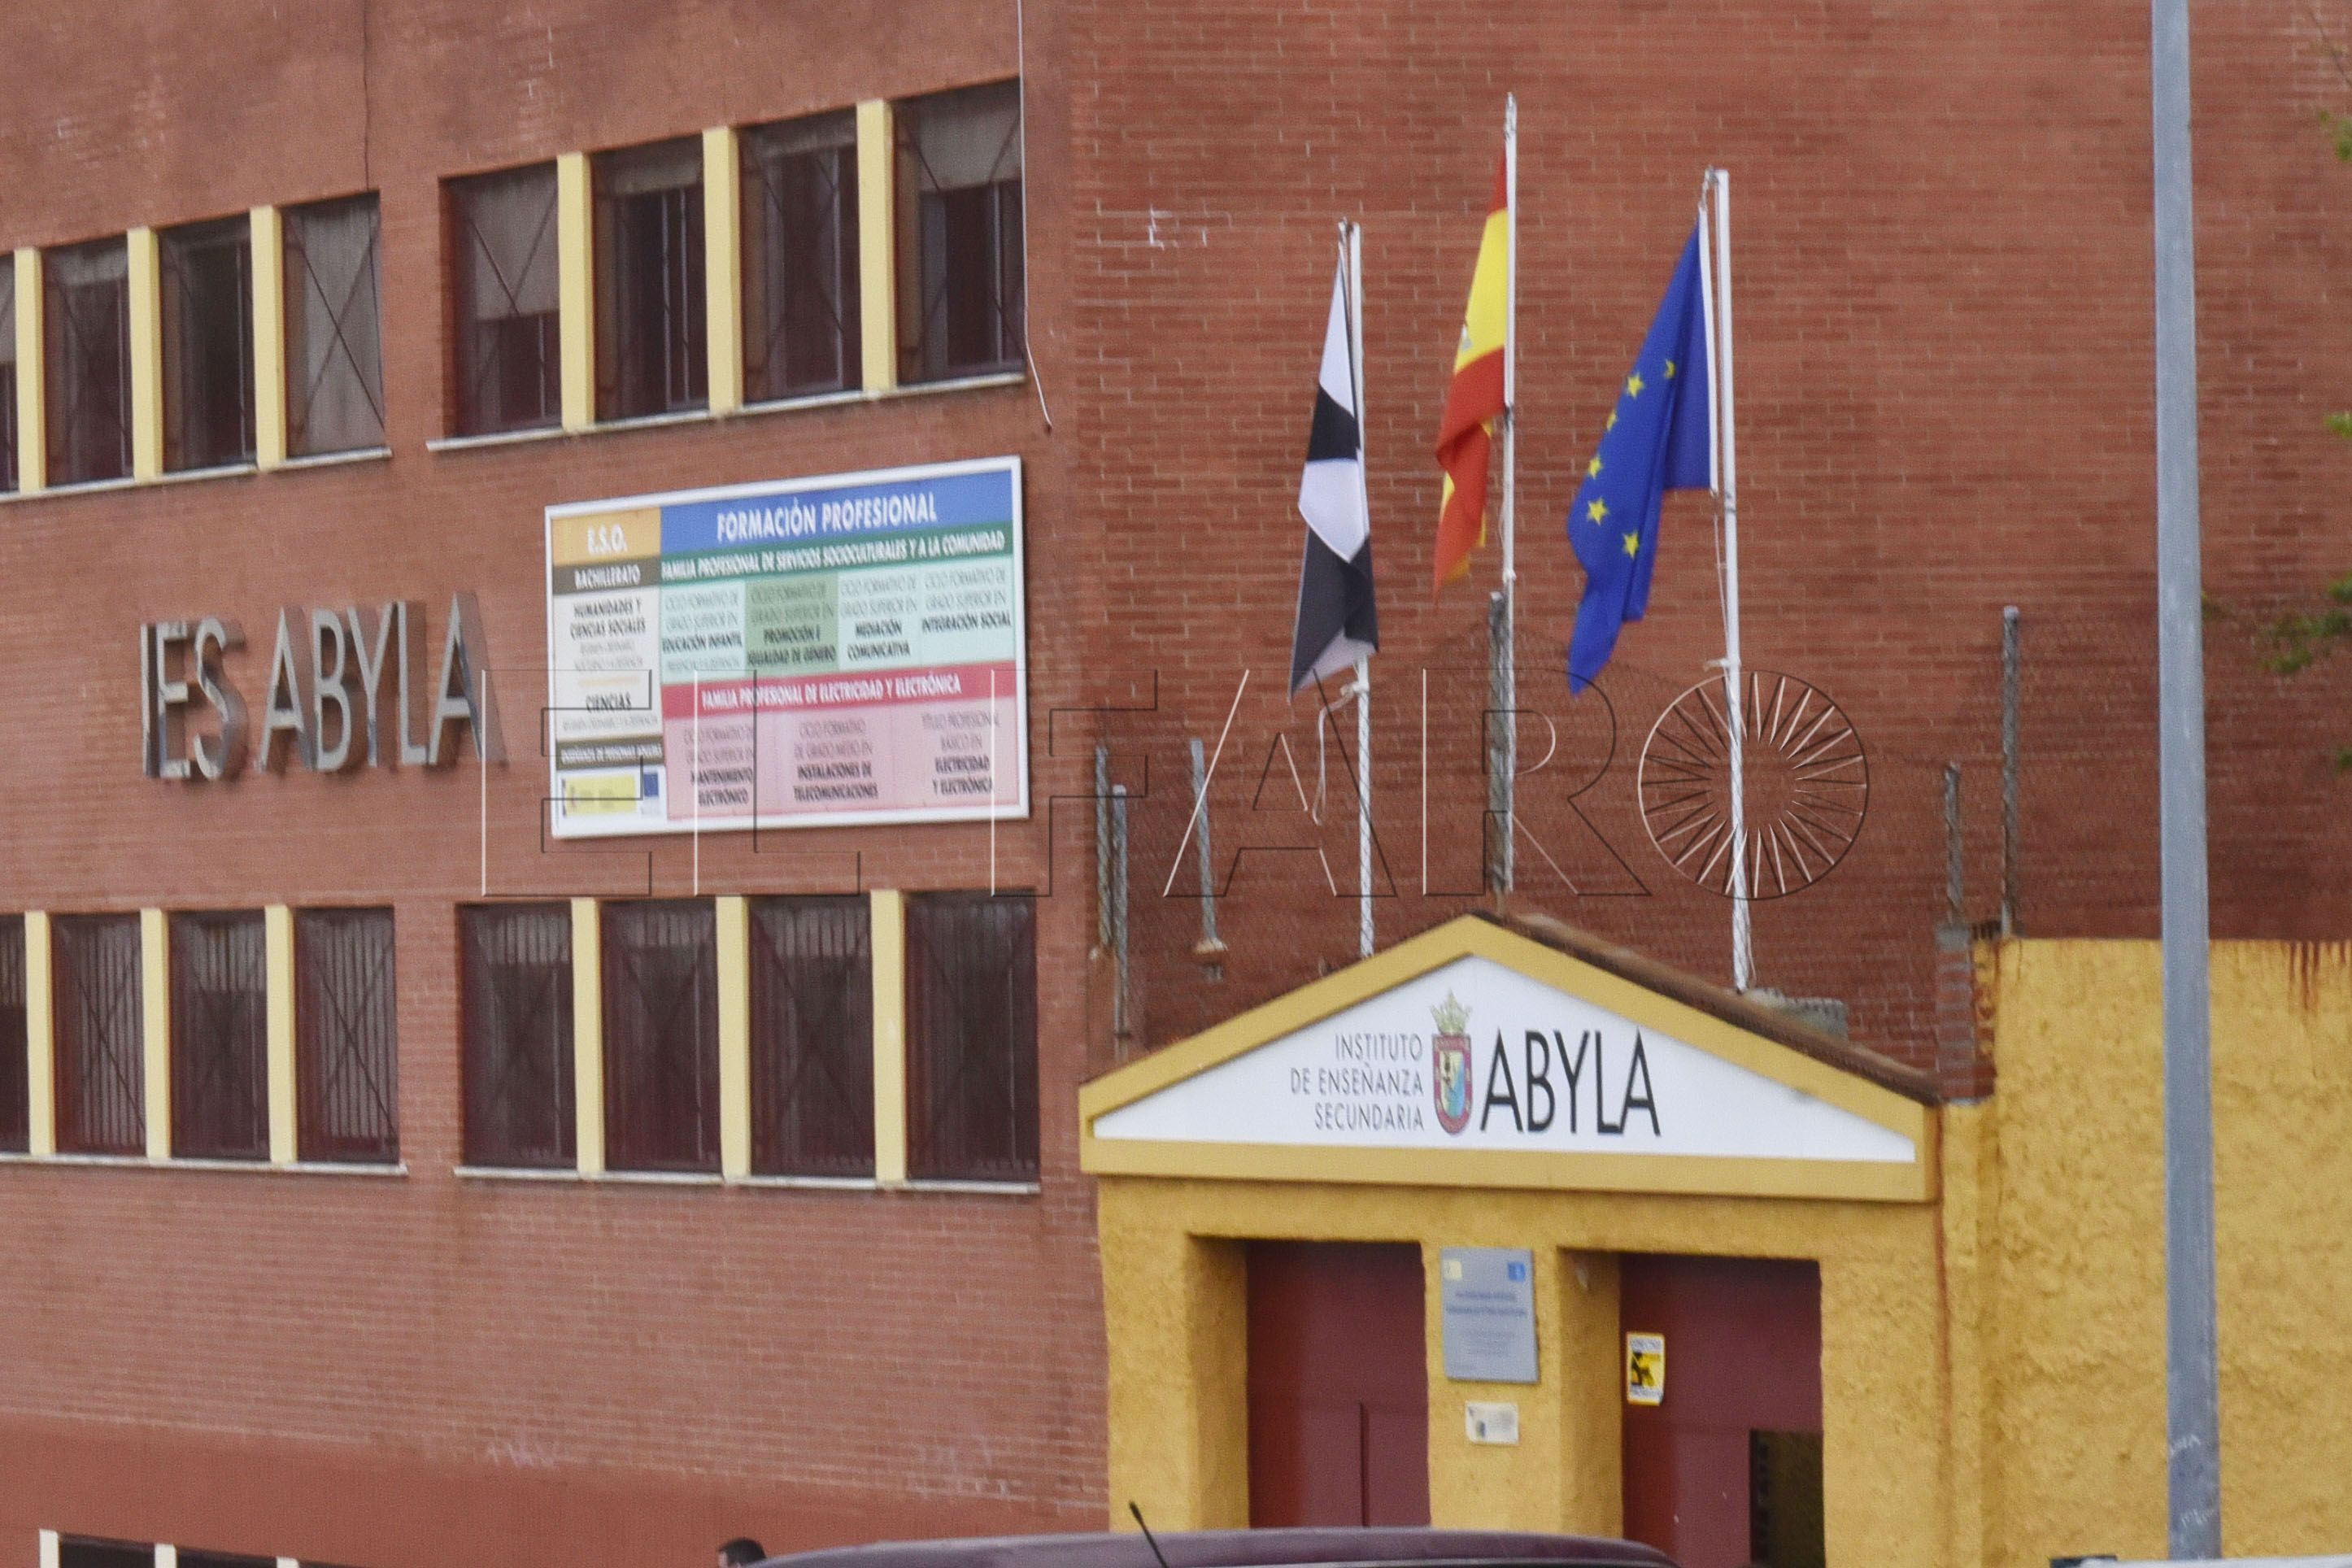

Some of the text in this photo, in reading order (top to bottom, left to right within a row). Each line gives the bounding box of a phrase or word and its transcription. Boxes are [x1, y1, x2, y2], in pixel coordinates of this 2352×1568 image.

[717, 491, 938, 544] FORMACIÓN PROFESIONAL
[661, 529, 1006, 581] FAMILIA PROFESIONAL DE SERVICIOS SOCIOCULTURALES Y A LA COMUNIDAD
[574, 564, 641, 590] BACHILLERATO
[140, 592, 496, 780] IES ABYLA
[586, 691, 632, 713] CIENCIAS
[702, 672, 962, 710] FAMILIA PROFESIONAL DE ELECTRICIDAD Y ELECTRÓNICA
[1335, 1033, 1423, 1062] INSTITUTO
[1291, 1062, 1424, 1096] DE ENSEÑANZA
[1480, 1026, 1662, 1137] ABYLA
[1314, 1102, 1425, 1133] SECUNDARIA
